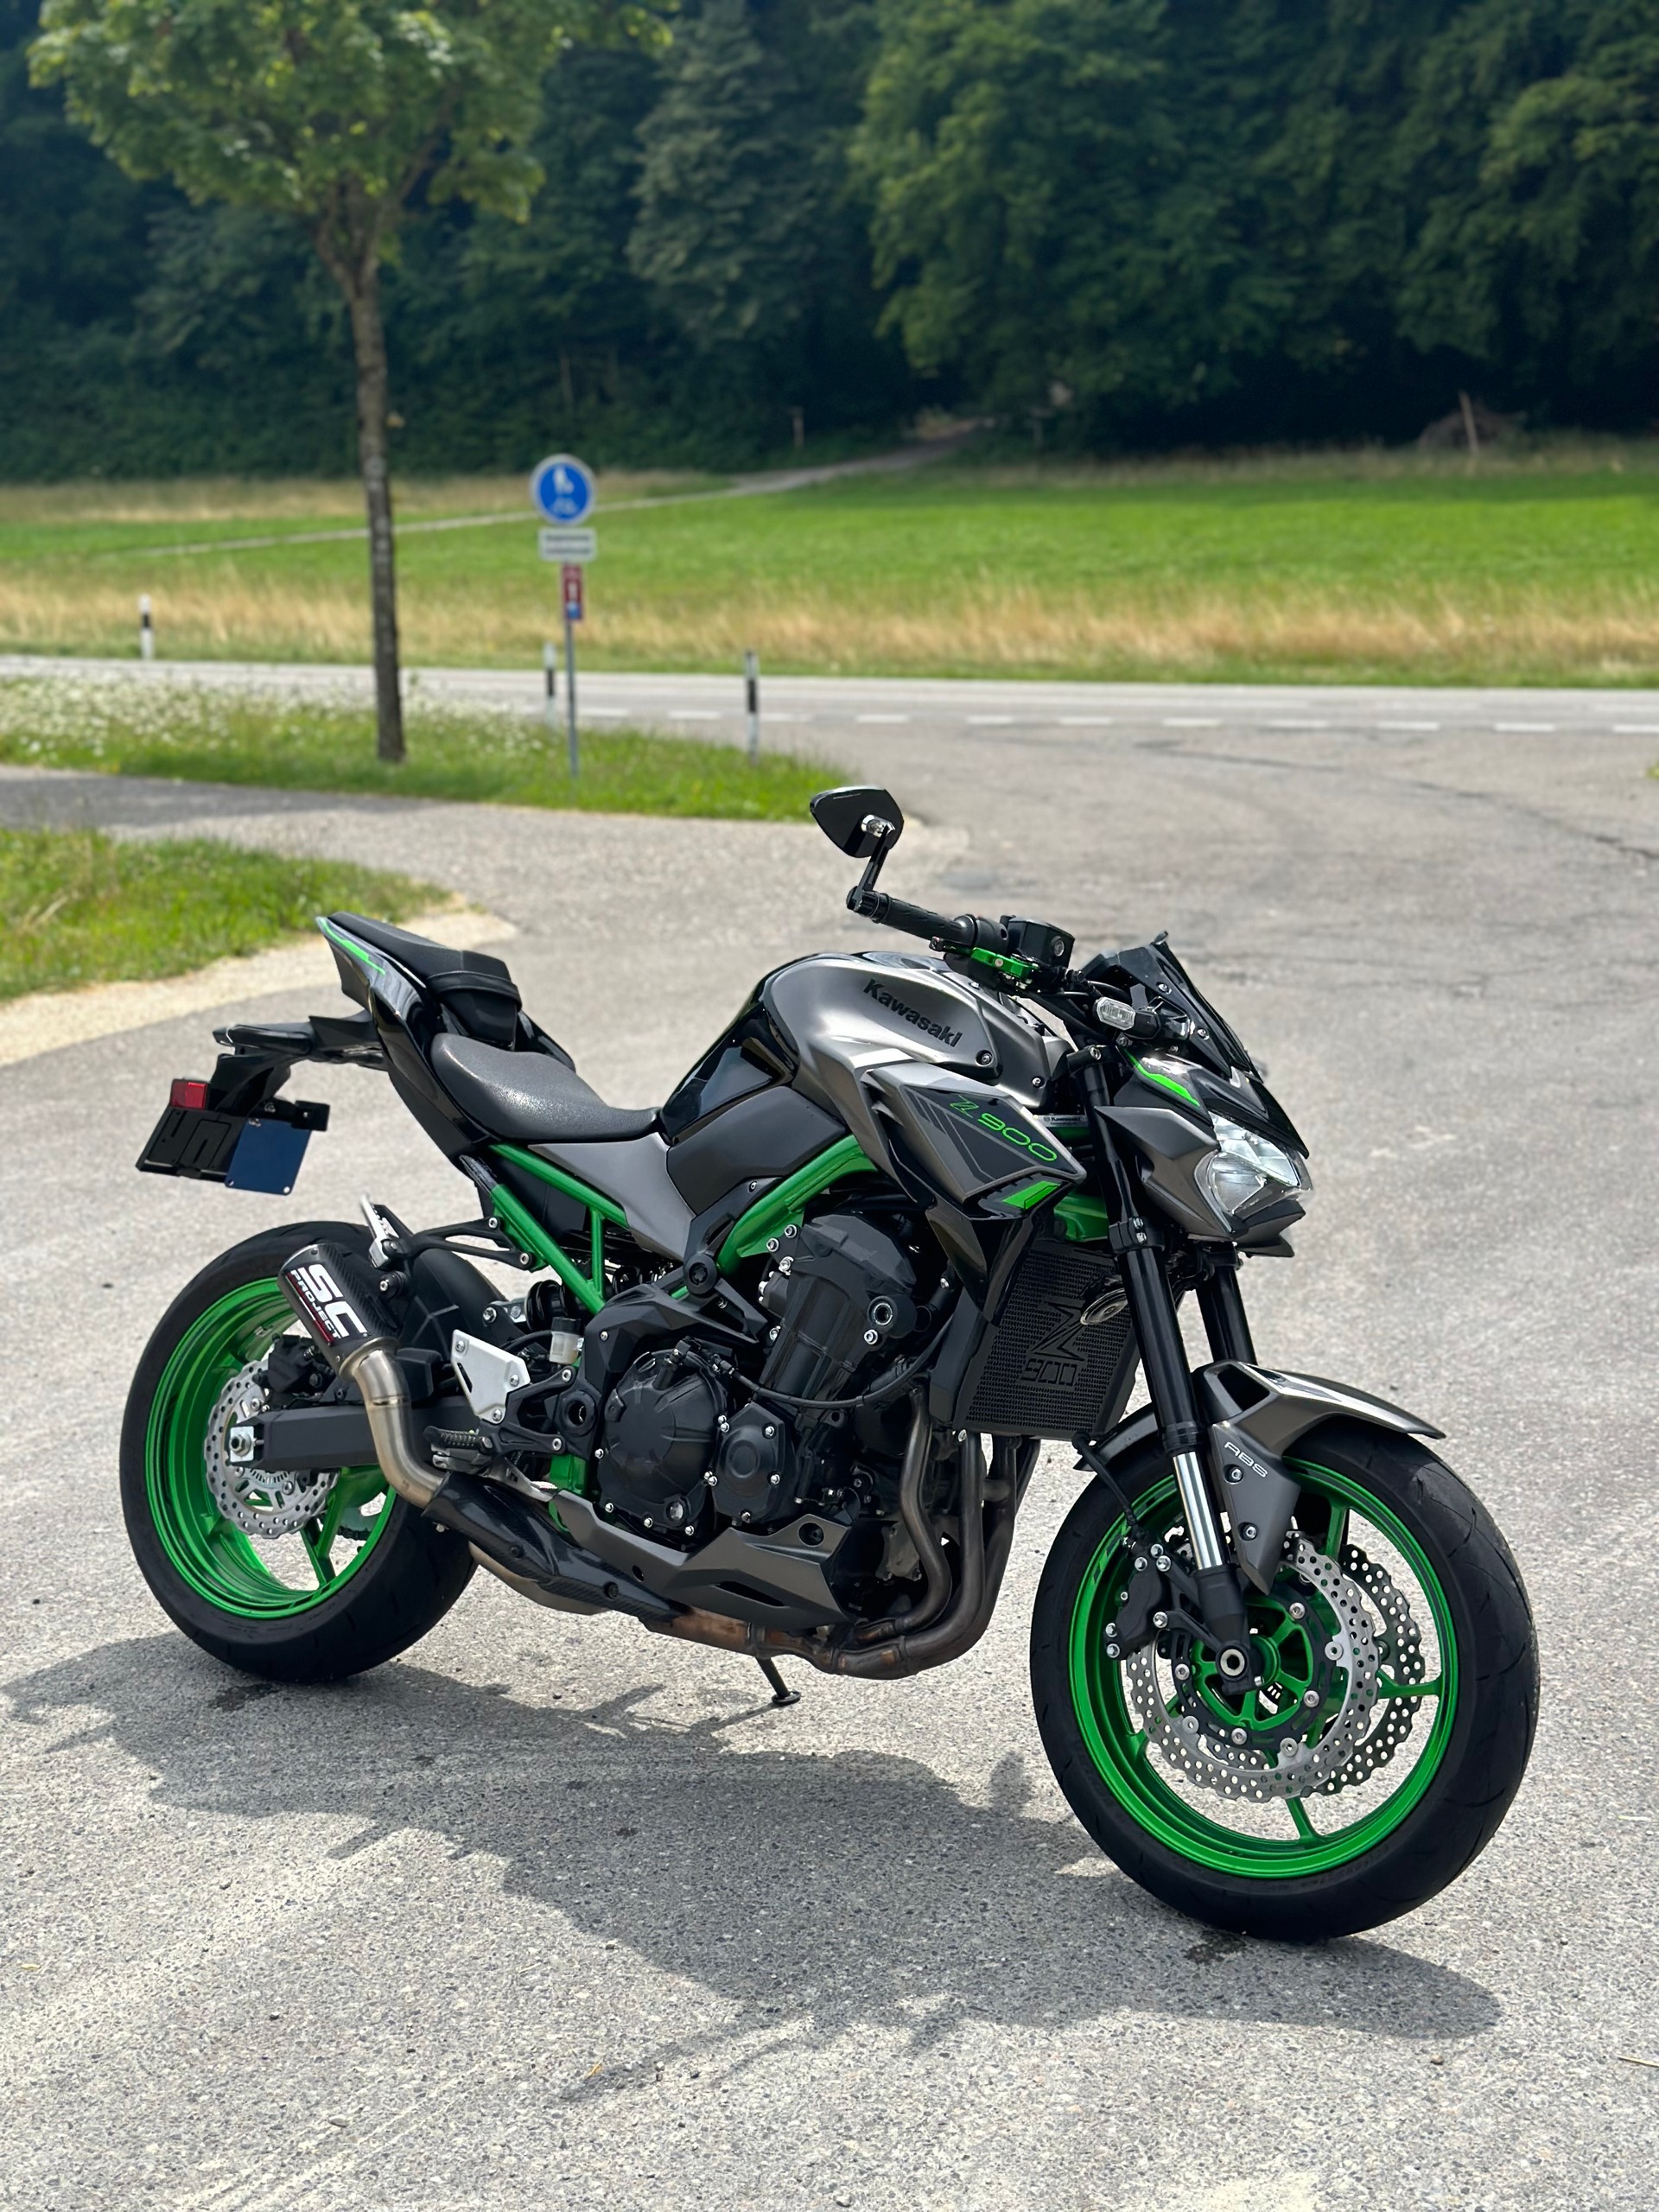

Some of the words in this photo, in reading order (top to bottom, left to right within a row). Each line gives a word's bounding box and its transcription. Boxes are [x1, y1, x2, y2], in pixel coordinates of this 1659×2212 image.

[863, 979, 963, 1047] Kawasaki
[289, 1269, 341, 1339] PROJECT
[297, 1263, 368, 1338] SC
[1224, 1441, 1268, 1478] ABS
